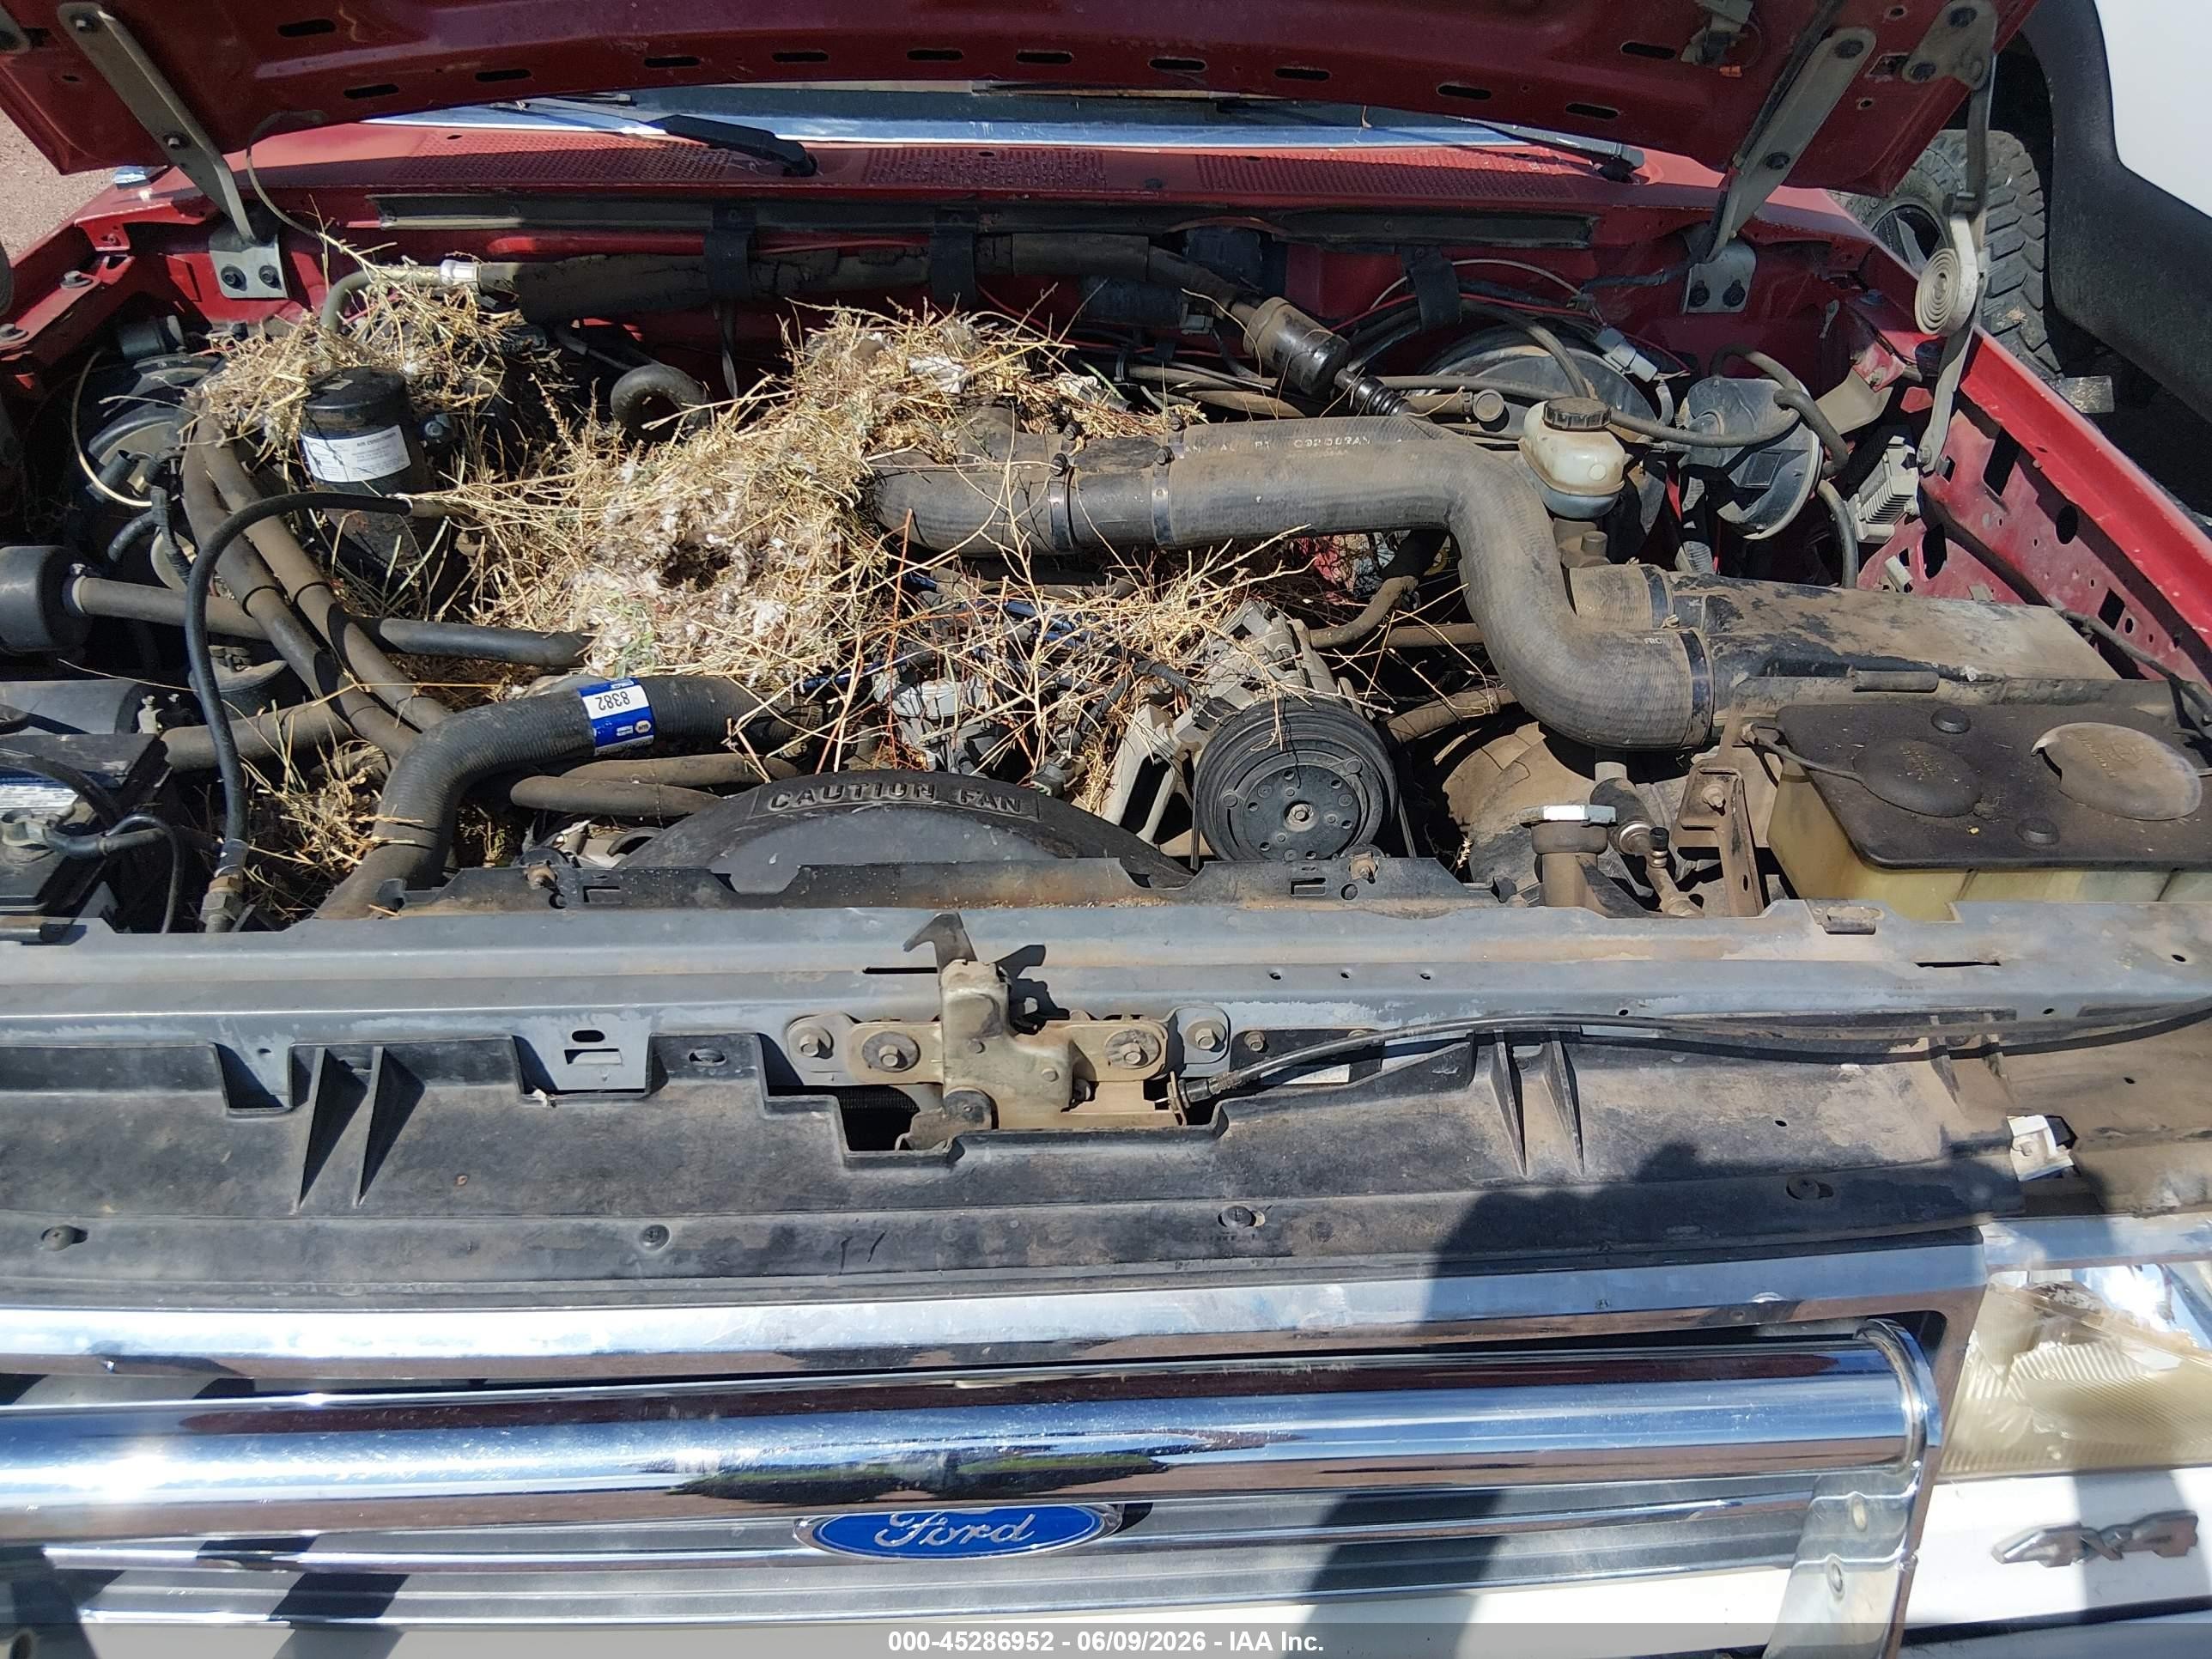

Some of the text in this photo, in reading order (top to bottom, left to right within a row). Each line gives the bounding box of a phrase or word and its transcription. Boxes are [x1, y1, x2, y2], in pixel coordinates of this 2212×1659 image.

[595, 690, 630, 710] 8382
[769, 782, 1023, 814] CAUTION FAN
[874, 1510, 1036, 1547] Ford
